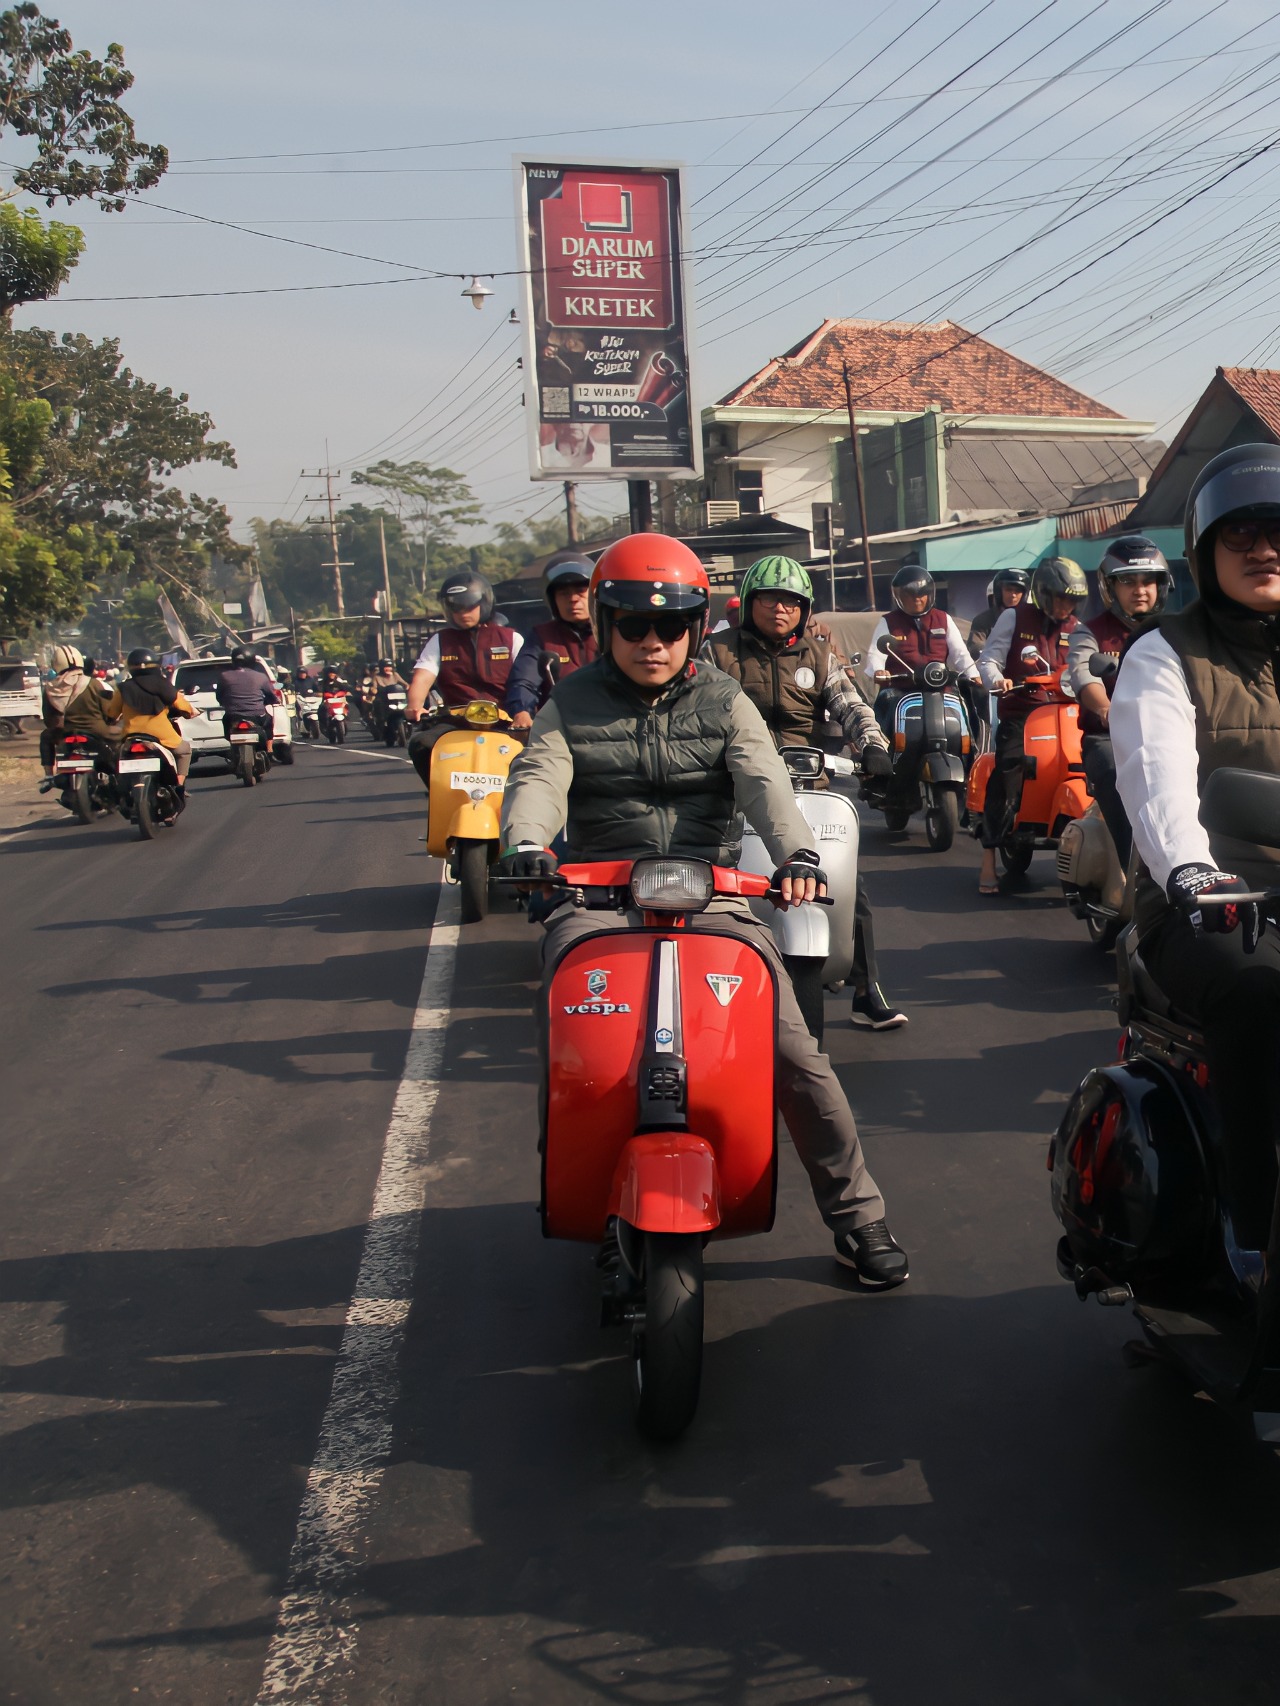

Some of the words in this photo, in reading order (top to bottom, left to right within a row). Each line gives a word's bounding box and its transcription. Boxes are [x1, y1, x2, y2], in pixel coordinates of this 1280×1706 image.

[528, 169, 560, 179] NEW
[561, 237, 654, 258] DJARUM
[572, 259, 646, 280] SUPER
[565, 296, 656, 318] KRETEK
[578, 387, 589, 397] 12
[593, 388, 636, 398] WRAPS
[563, 1003, 632, 1016] vespa
